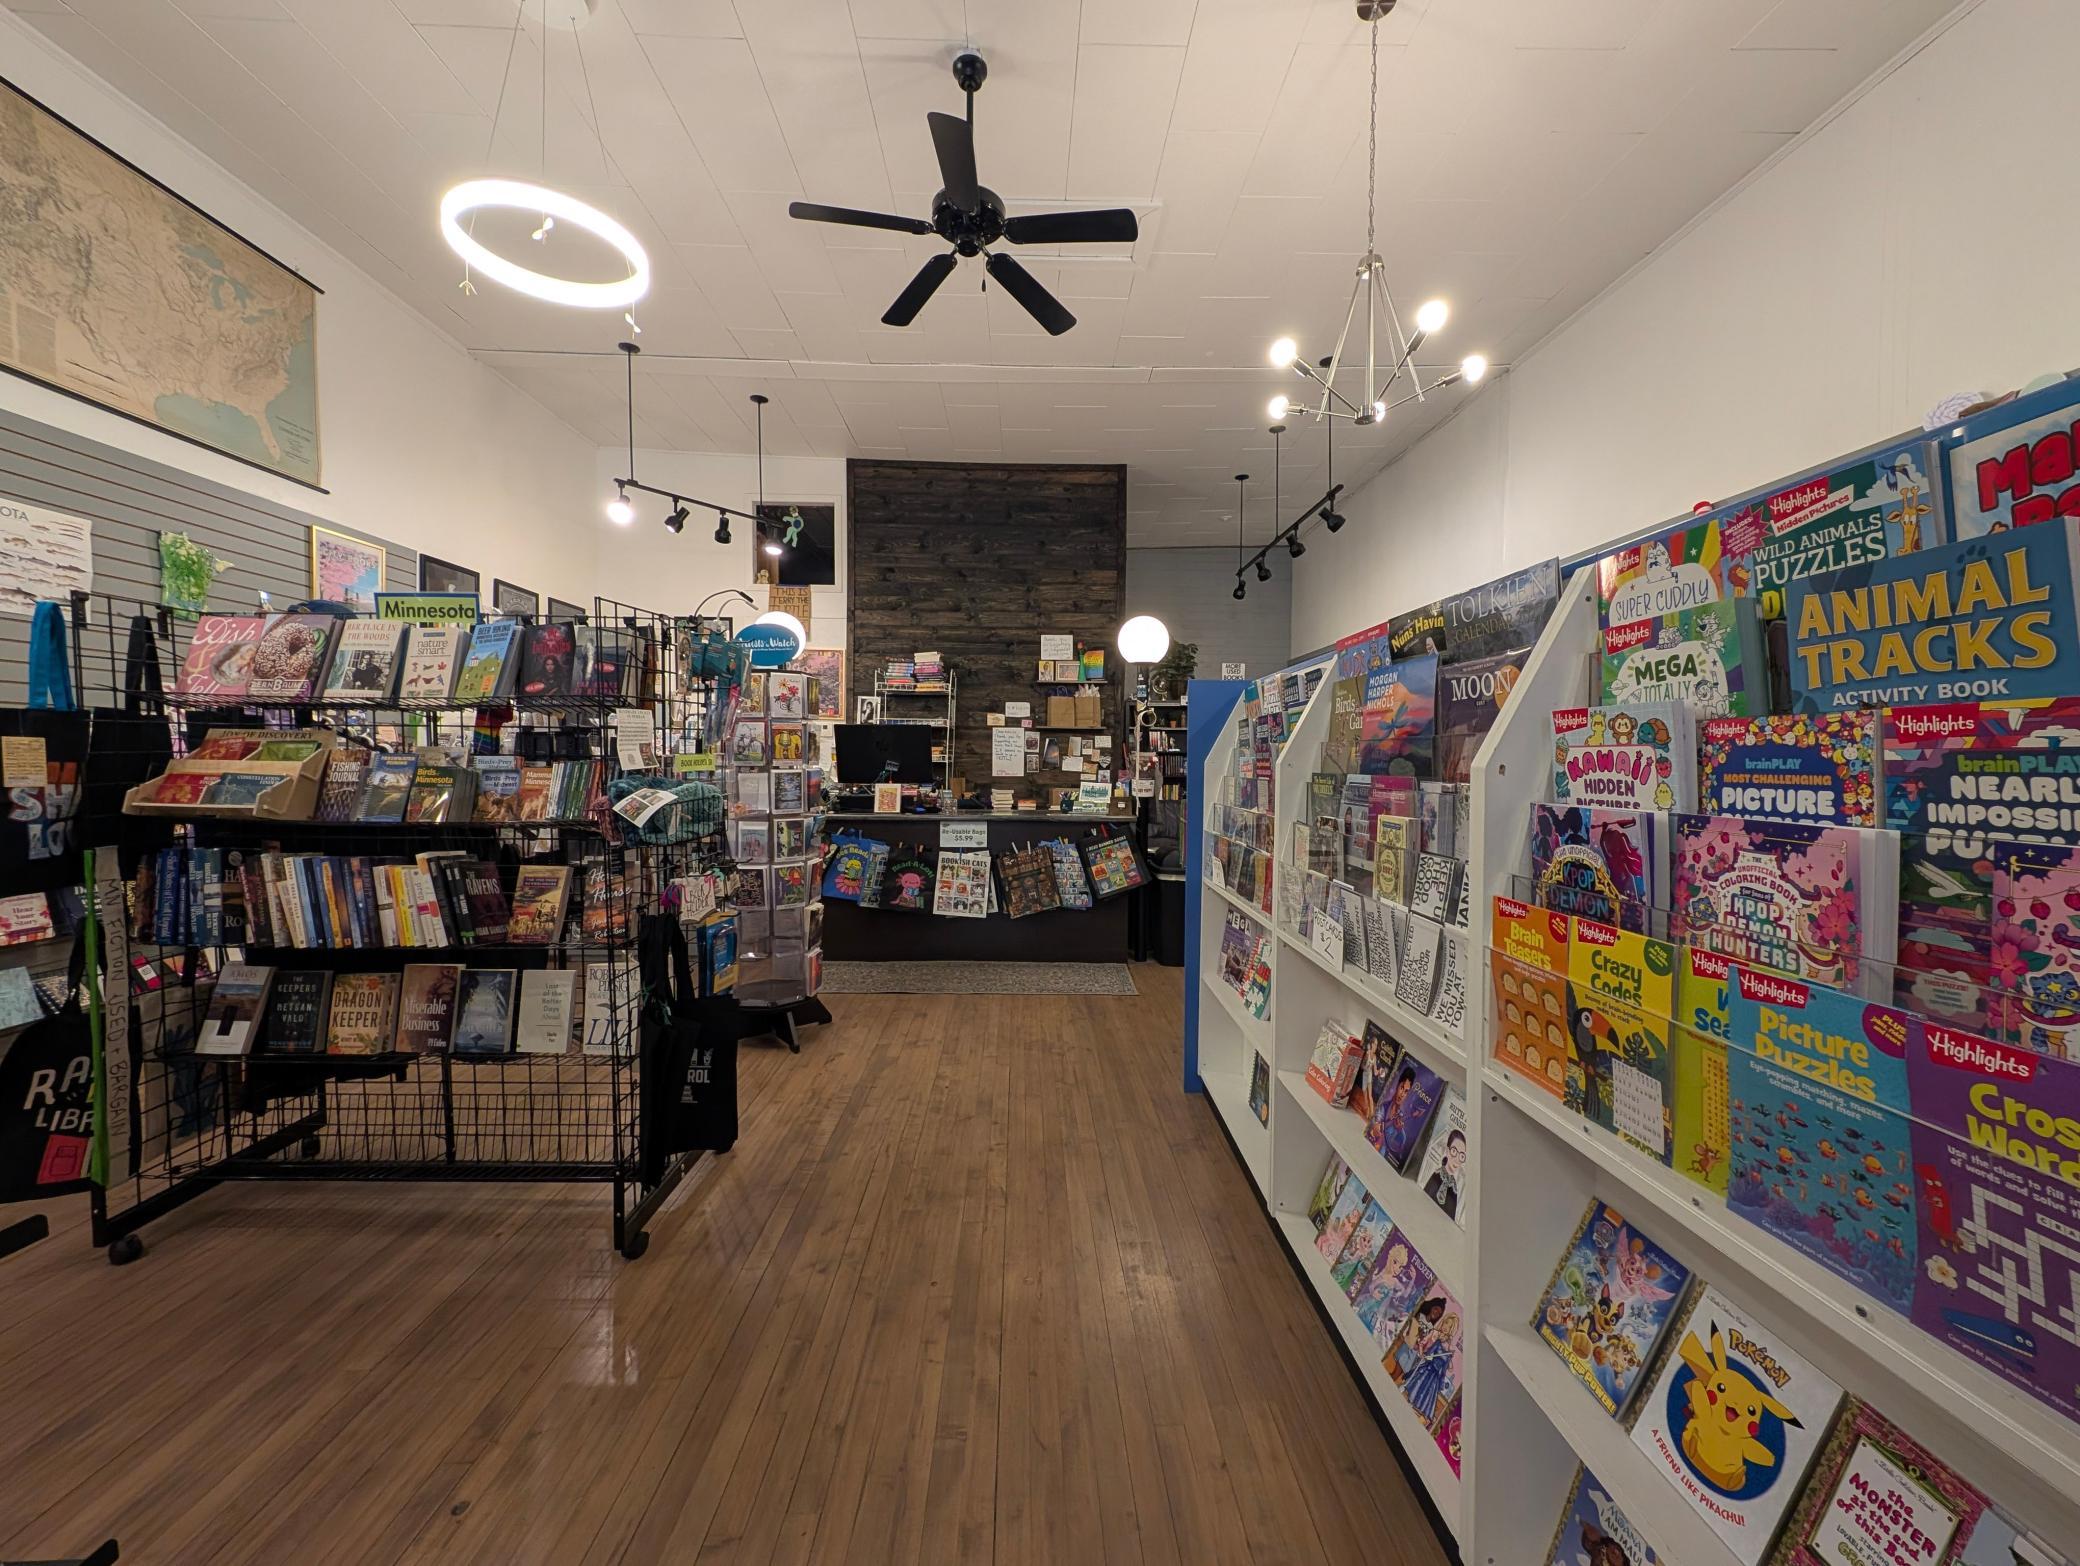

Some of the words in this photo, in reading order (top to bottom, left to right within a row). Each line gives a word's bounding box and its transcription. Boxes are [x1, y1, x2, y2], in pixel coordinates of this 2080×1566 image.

[1770, 485, 1827, 515] Highlights
[1776, 508, 1811, 533] Hidden
[1754, 539, 1796, 562] WILD
[1800, 513, 1882, 550] ANIMALS
[1755, 532, 1887, 590] PUZZLES
[1448, 567, 1548, 628] TOLKIEN
[1616, 594, 1652, 622] SUPER
[1656, 579, 1709, 612] CUDDLY
[1797, 547, 2049, 641] ANIMAL
[385, 600, 475, 619] Minnesota
[191, 617, 259, 645] Dish
[348, 633, 361, 641] THE
[363, 633, 390, 641] WOODS
[1392, 625, 1414, 652] Nuns
[1456, 613, 1513, 644] CALENDAR
[1606, 625, 1650, 648] Highlights
[417, 640, 448, 649] nature
[417, 647, 445, 655] smart
[770, 637, 796, 648] Watch
[1797, 611, 2057, 690] TRACKS
[1369, 671, 1399, 687] MORGAN
[1634, 653, 1698, 687] MEGA
[1368, 685, 1394, 700] HARPER
[1451, 667, 1513, 702] MOON
[1643, 680, 1692, 703] TOTALLY
[1832, 684, 1929, 707] ACTIVITY
[1937, 678, 2010, 699] BOOK
[1335, 697, 1356, 714] Birds
[1366, 697, 1394, 712] NICHOLS
[258, 730, 314, 739] DISCOVERY
[1553, 711, 1588, 731] Highlights
[1706, 720, 1746, 738] Highlights
[1896, 714, 1975, 737] Highlights
[331, 761, 361, 773] FISHING
[416, 768, 437, 777] Birds
[1745, 757, 1803, 770] brainPLAY
[328, 772, 361, 783] JOURNAL
[415, 776, 454, 785] Minnesota
[1584, 778, 1636, 798] HIDDEN
[1723, 774, 1751, 785] MOST
[1752, 774, 1832, 787] CHALLENGING
[1721, 787, 1836, 816] PICTURE
[971, 828, 986, 837] Bags
[972, 859, 988, 868] CATS
[1737, 866, 1778, 880] UNOFFICIAL
[1752, 856, 1762, 864] THE
[465, 878, 500, 896] RAVENS
[1421, 858, 1435, 904] GOOD
[1431, 859, 1441, 890] THE
[1437, 860, 1450, 902] KEEP
[1563, 863, 1595, 889] KPOP
[102, 878, 121, 907] MN
[414, 881, 424, 900] prep
[1719, 875, 1768, 891] COLORING
[1769, 880, 1799, 906] BOOK
[12, 906, 34, 915] Hear
[14, 918, 38, 926] Story
[15, 912, 35, 920] Your
[1498, 900, 1527, 918] Highlights
[1733, 896, 1781, 921] KPOP
[1313, 911, 1343, 942] POSTCARDS
[1510, 921, 1544, 950] Brain
[1577, 922, 1616, 945] Highlights
[108, 918, 126, 982] FICTION
[1319, 933, 1335, 960] $2
[1503, 938, 1551, 970] Teasers
[1711, 931, 1798, 972] HUNTERS
[1410, 950, 1425, 1006] POSTCARD
[1439, 937, 1459, 997] MISSED
[1590, 949, 1643, 992] Crazy
[333, 991, 383, 1009] DRAGON
[1590, 974, 1643, 1009] Codes
[1740, 974, 1805, 1006] Highlights
[107, 993, 127, 1042] USED
[332, 1011, 379, 1028] KEEPER
[402, 998, 448, 1016] Miserable
[1442, 991, 1457, 1027] YOU
[401, 1016, 440, 1032] Business
[1760, 1005, 1870, 1068] Picture
[1755, 1033, 1877, 1102] Puzzles
[1927, 1031, 2030, 1078] Highlights
[108, 1060, 129, 1137] BARGAIN
[1413, 1081, 1432, 1105] Prince
[1947, 1144, 1969, 1161] Use
[1971, 1151, 1989, 1168] the
[1993, 1162, 2024, 1184] clues
[2028, 1178, 2041, 1191] to
[2046, 1184, 2065, 1201] fill
[1950, 1157, 1964, 1168] of
[1965, 1163, 2001, 1185] words
[2004, 1181, 2028, 1197] and
[2031, 1192, 2067, 1214] solve
[1411, 1254, 1436, 1282] FROZEN
[1571, 1354, 1585, 1376] PUP
[1651, 1428, 1659, 1438] A
[1655, 1437, 1681, 1475] FRIEND
[1680, 1474, 1700, 1497] LIKE
[1699, 1492, 1746, 1527] PIKACHU!
[1849, 1472, 1937, 1558] MONSTER
[1887, 1488, 1914, 1519] the
[1604, 1516, 1618, 1537] AM
[1607, 1504, 1642, 1552] MOANA
[1836, 1498, 1855, 1514] of
[1855, 1513, 1884, 1545] this
[1836, 1524, 1866, 1558] LOVABLE,
[1869, 1509, 1891, 1535] the
[1892, 1533, 1921, 1562] end
